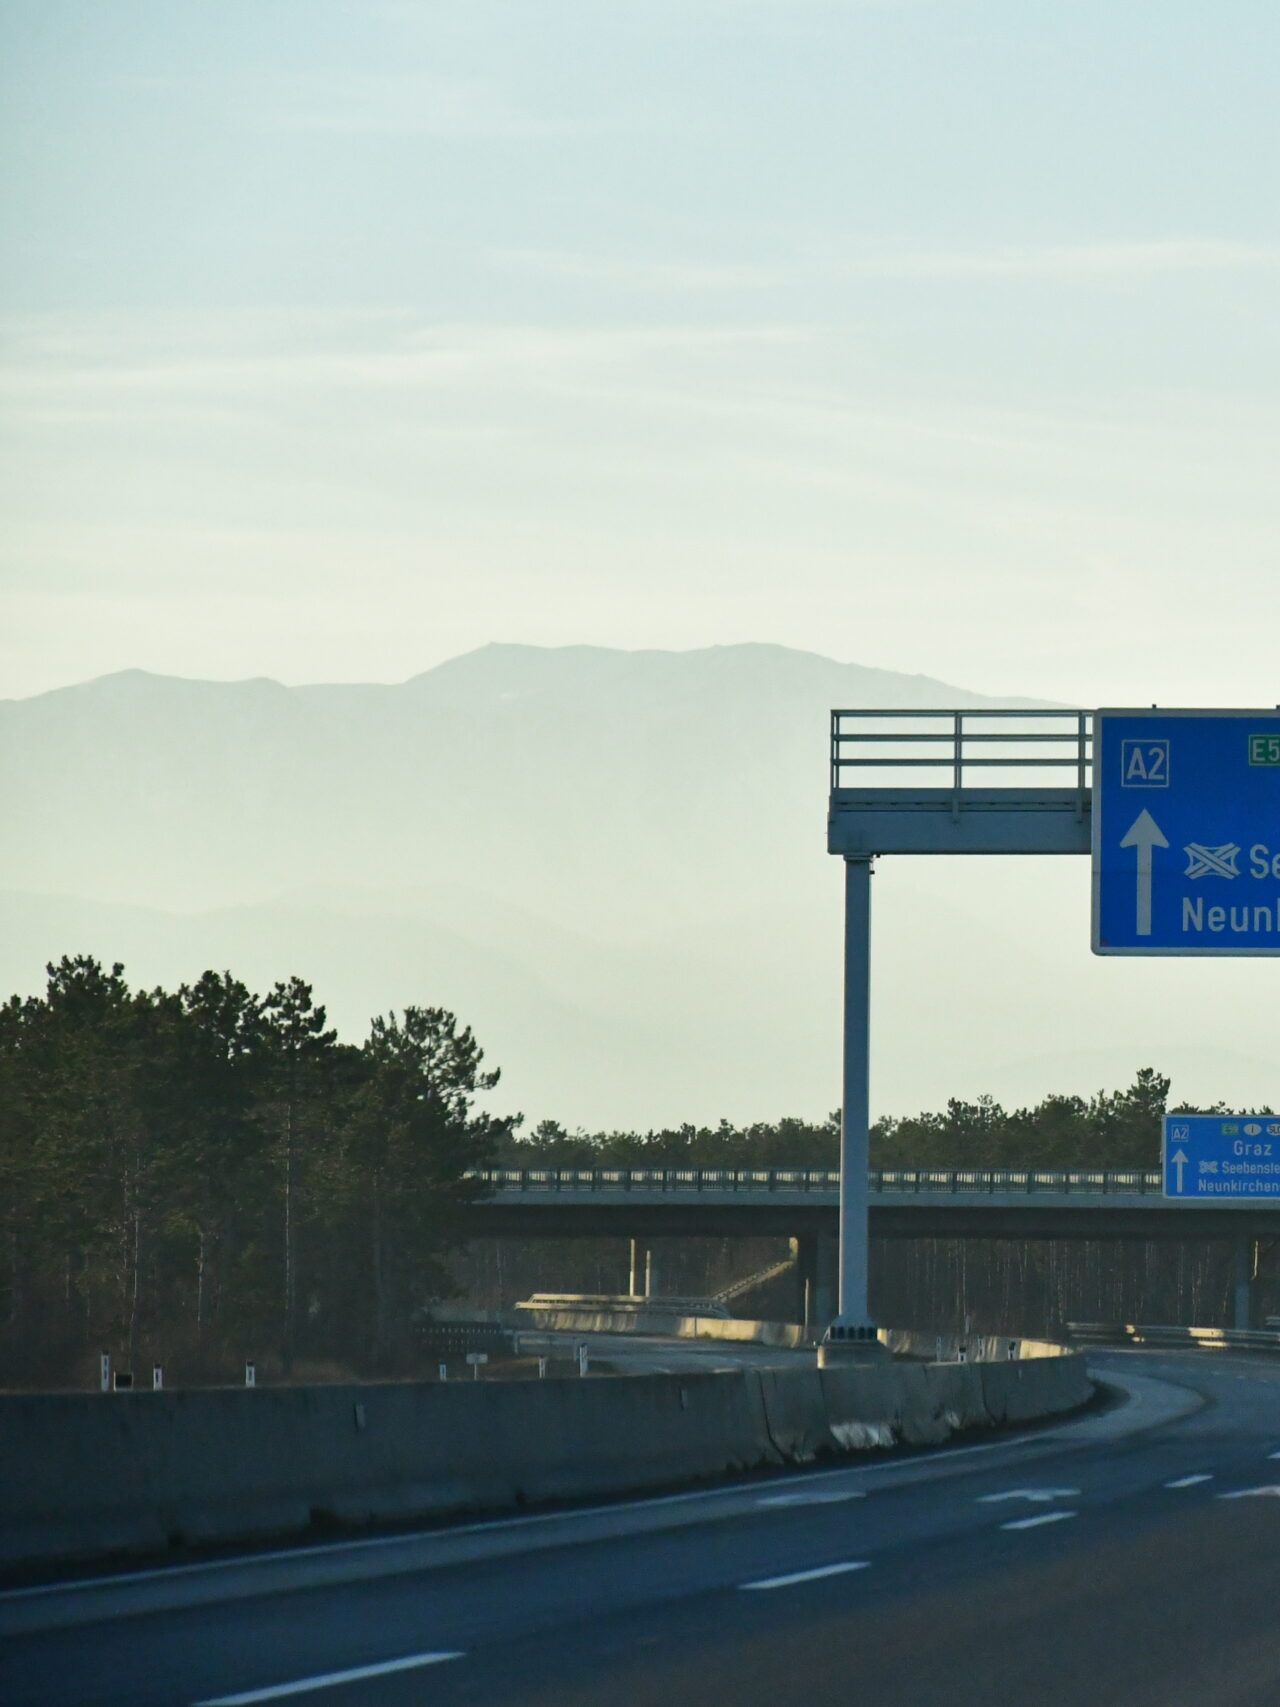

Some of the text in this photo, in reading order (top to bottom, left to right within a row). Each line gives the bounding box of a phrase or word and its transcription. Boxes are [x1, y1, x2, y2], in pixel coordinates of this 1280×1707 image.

[1126, 747, 1165, 781] A2
[1173, 1127, 1188, 1140] A2
[1234, 1140, 1273, 1156] Graz
